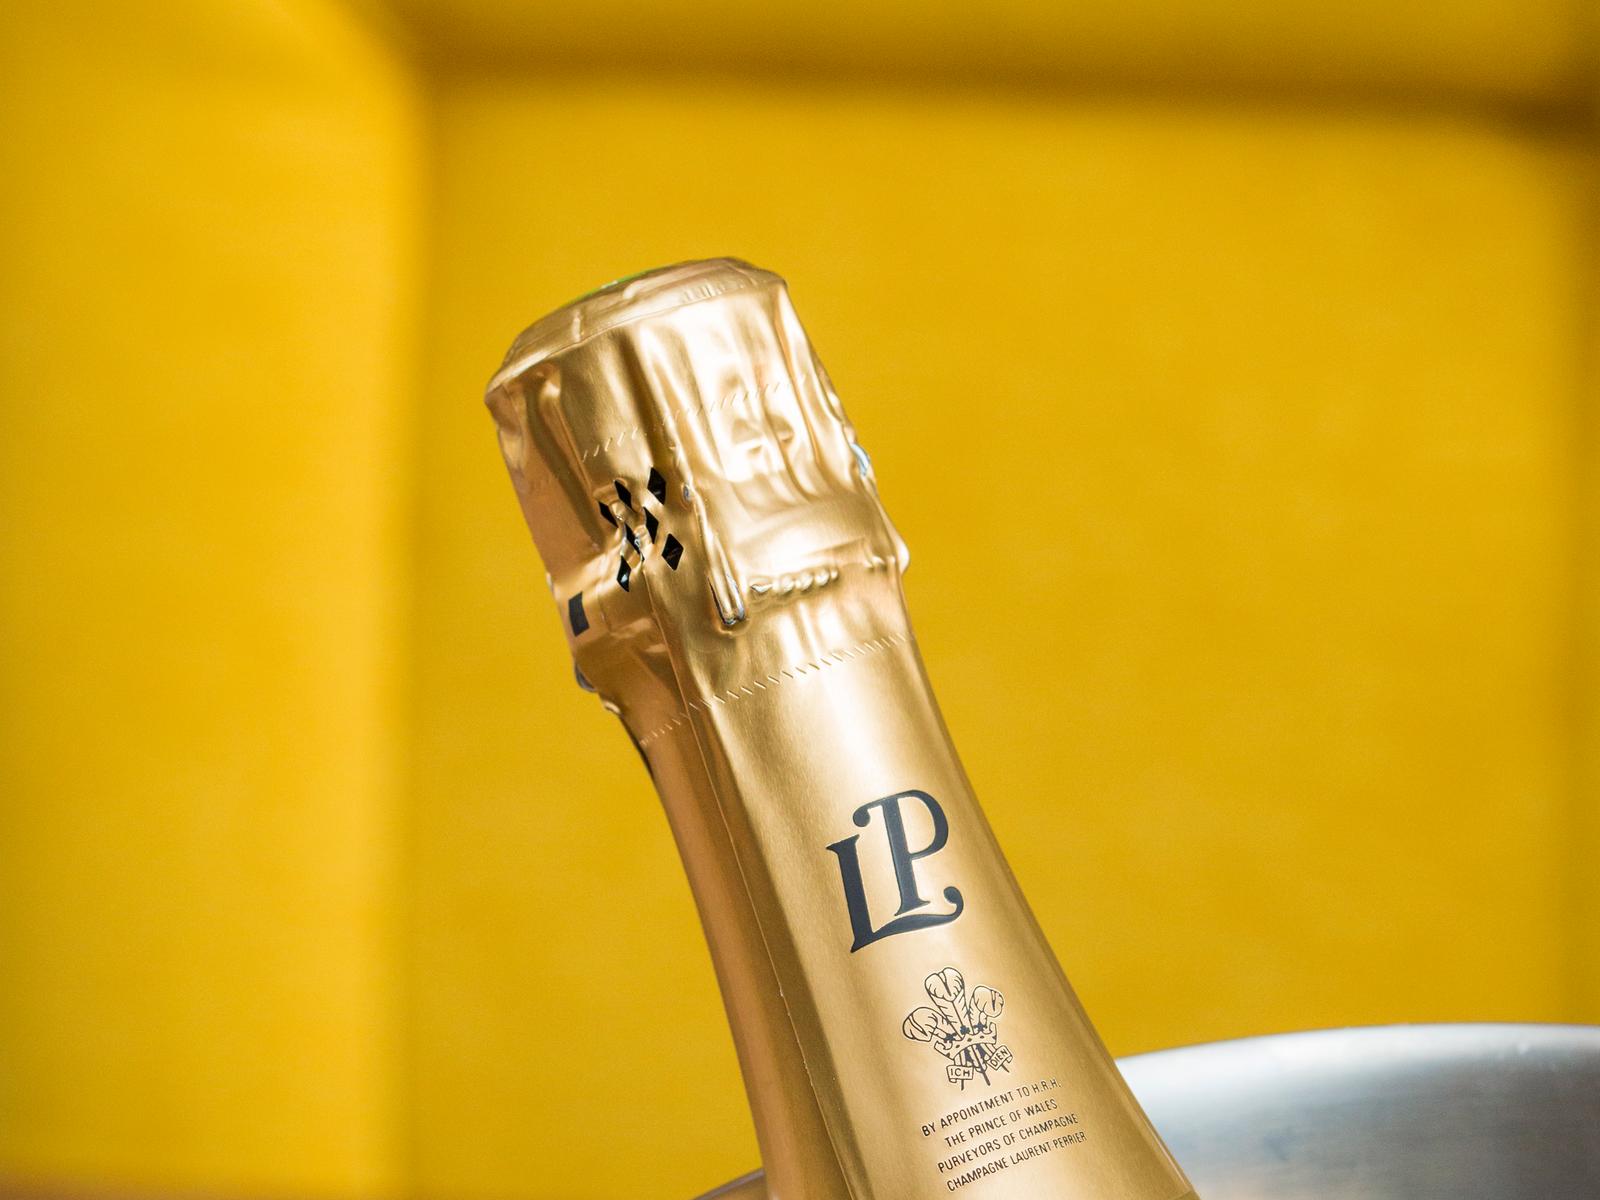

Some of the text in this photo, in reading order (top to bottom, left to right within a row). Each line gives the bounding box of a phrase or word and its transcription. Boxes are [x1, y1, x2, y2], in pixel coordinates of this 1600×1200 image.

[950, 1048, 1008, 1078] ICH DIEN
[921, 1079, 1061, 1137] BY APPOINTMENT TO H.R.H.
[944, 1098, 1058, 1148] THE PRINCE OF WALES
[937, 1113, 1079, 1173] PURVEYORS OF CHAMPAGNE
[946, 1157, 1010, 1192] CHAMPAGNE
